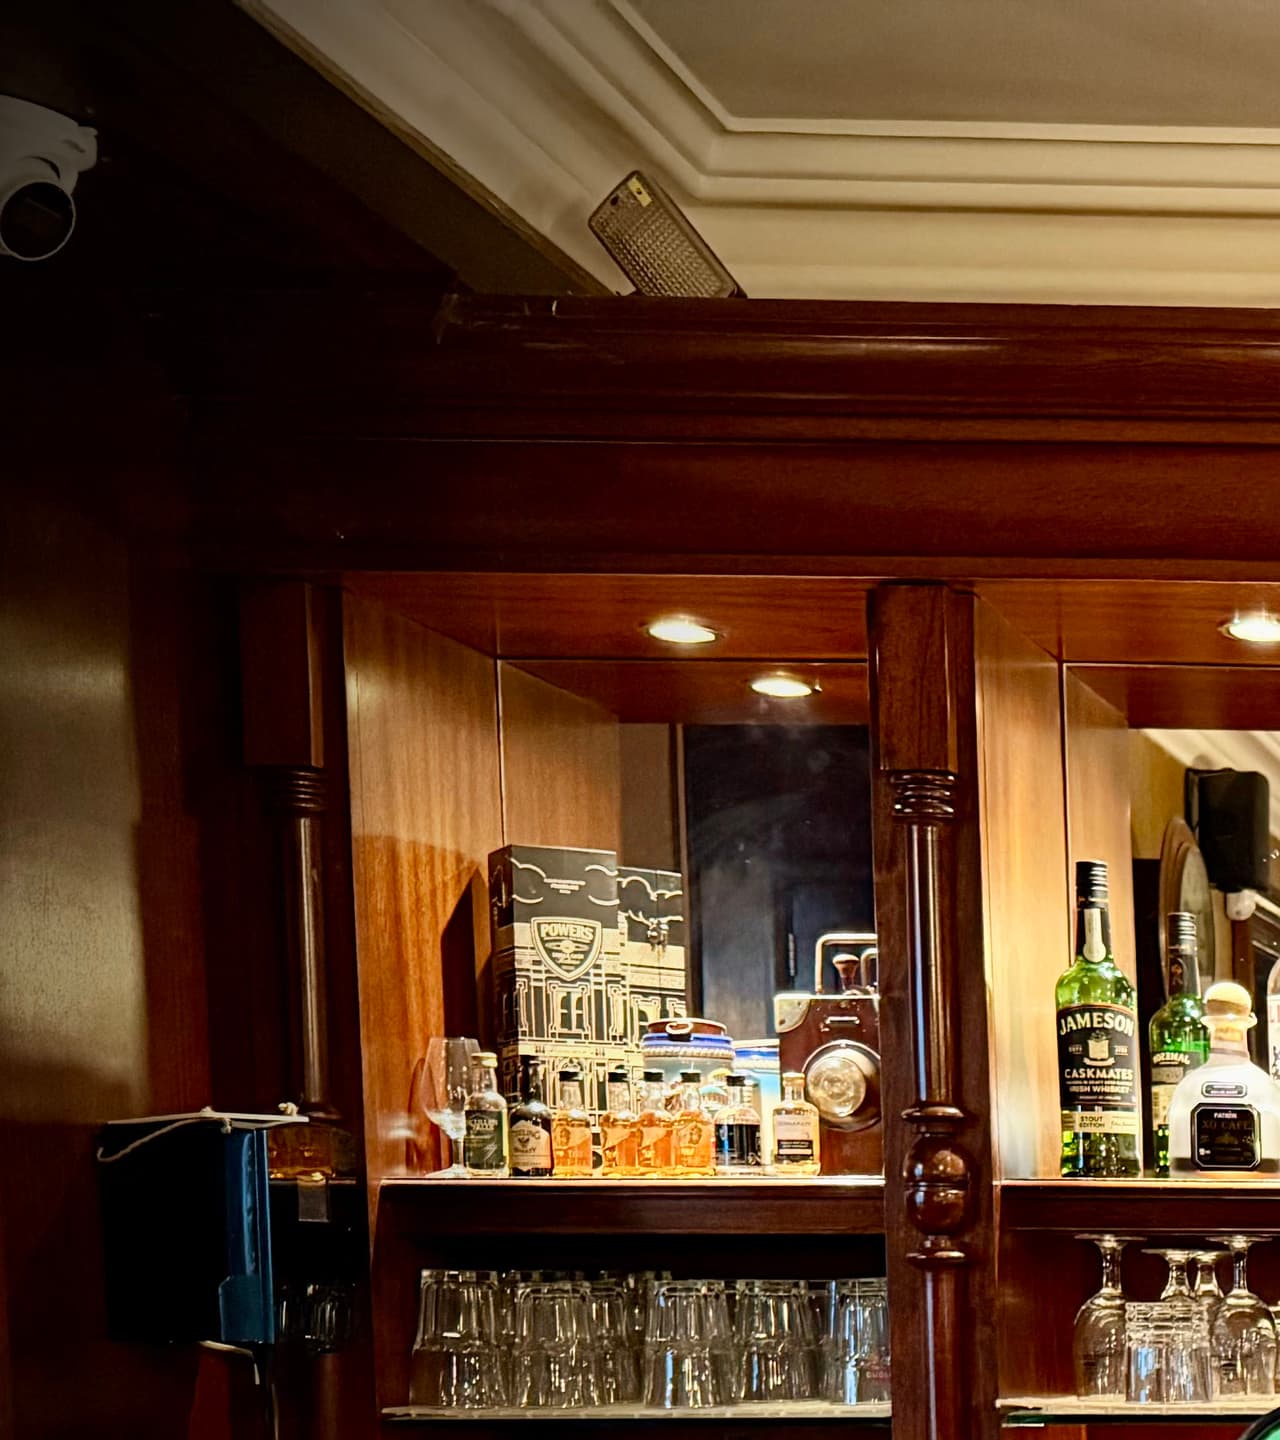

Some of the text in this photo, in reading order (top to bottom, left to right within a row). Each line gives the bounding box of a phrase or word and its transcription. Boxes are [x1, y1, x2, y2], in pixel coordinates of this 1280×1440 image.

[540, 923, 594, 940] POWERS
[1059, 1011, 1135, 1037] JAMESON
[1064, 1068, 1134, 1080] CASKMATES
